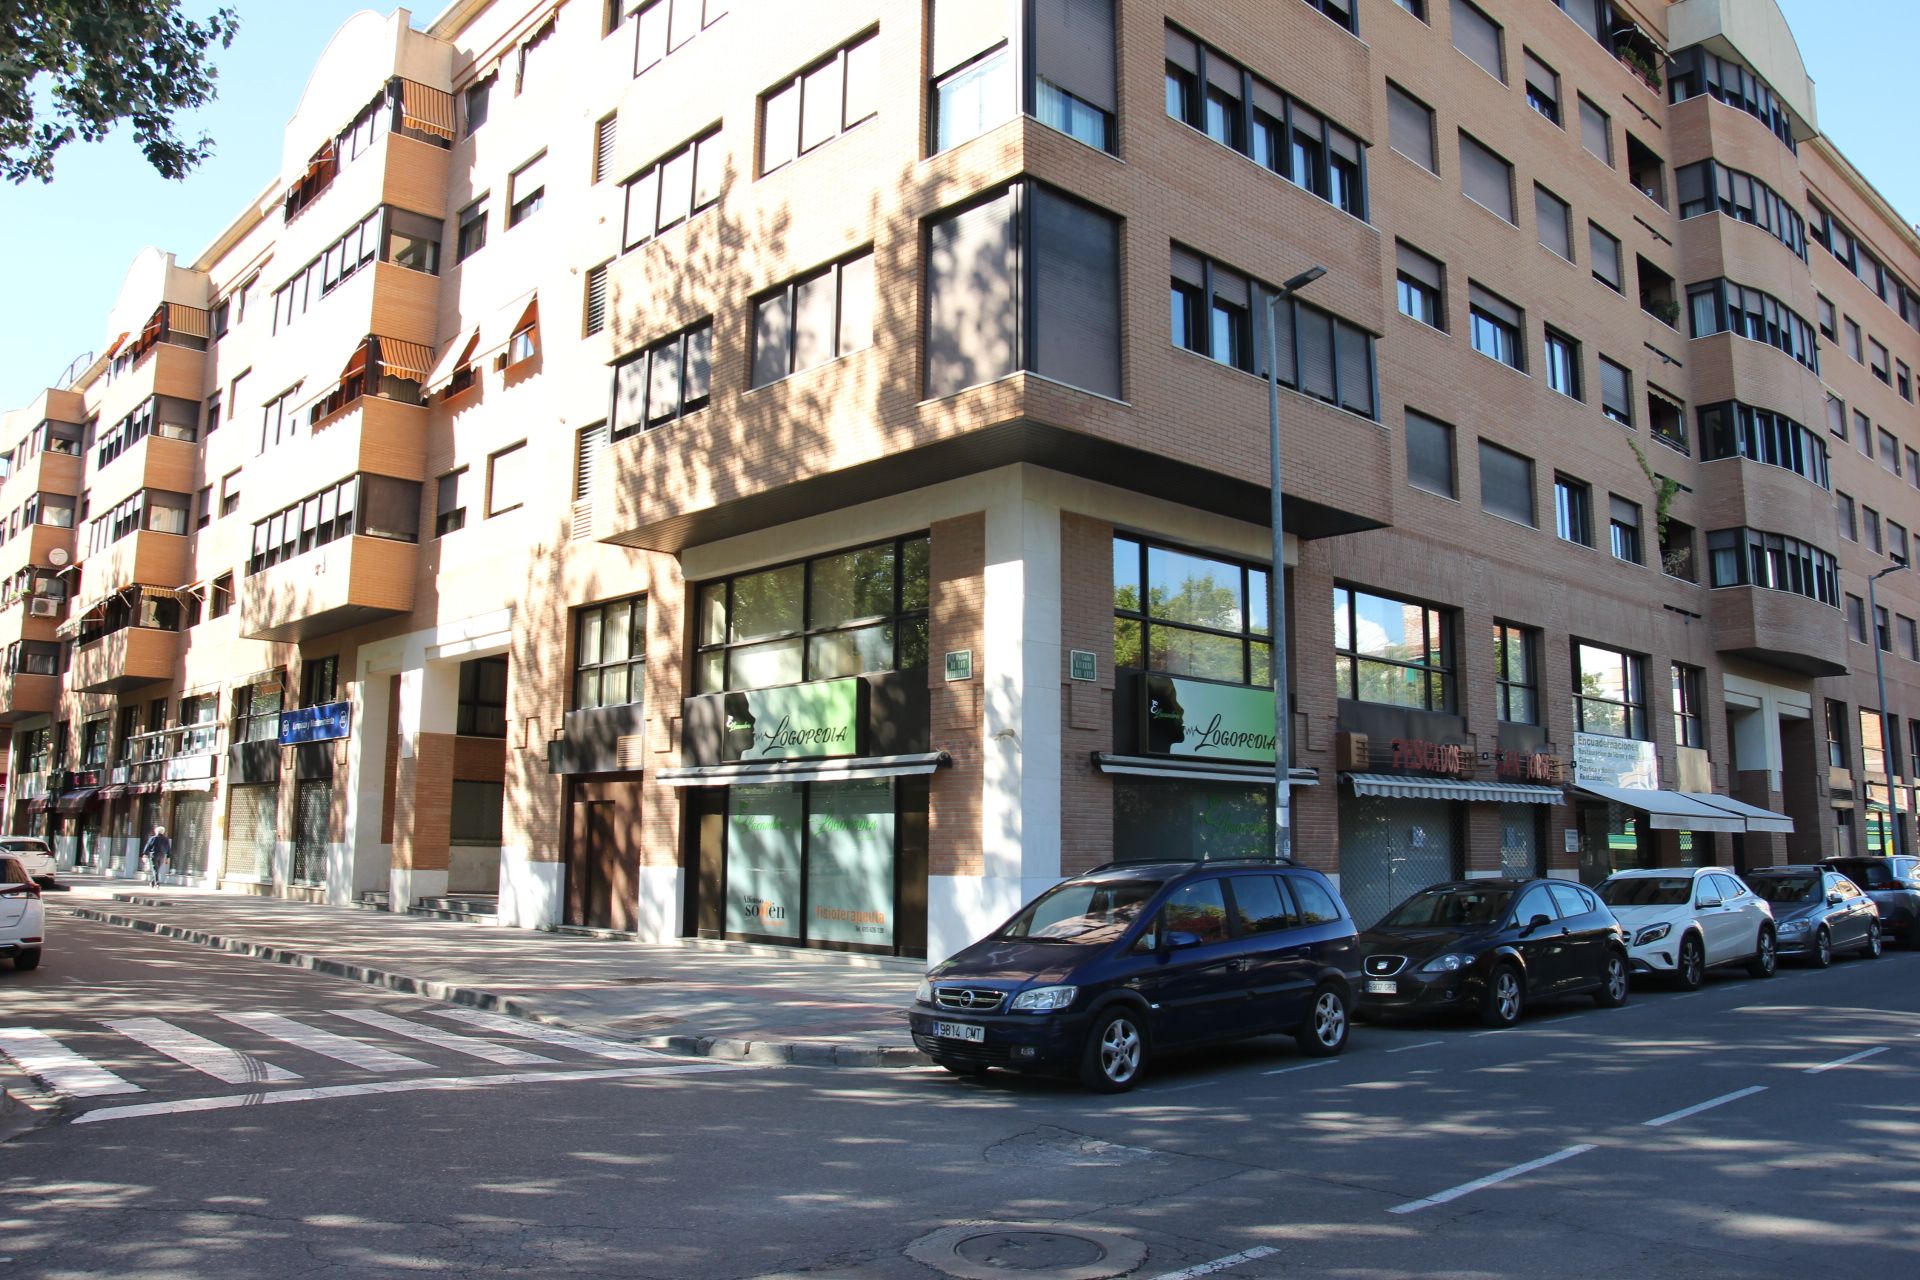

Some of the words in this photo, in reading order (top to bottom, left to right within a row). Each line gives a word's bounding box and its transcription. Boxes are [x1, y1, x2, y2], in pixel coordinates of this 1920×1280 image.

[762, 714, 848, 756] LOGOPEDIA
[1194, 713, 1276, 752] LOGOPEDIA
[940, 1023, 960, 1037] 9814
[965, 1027, 981, 1040] CMT
